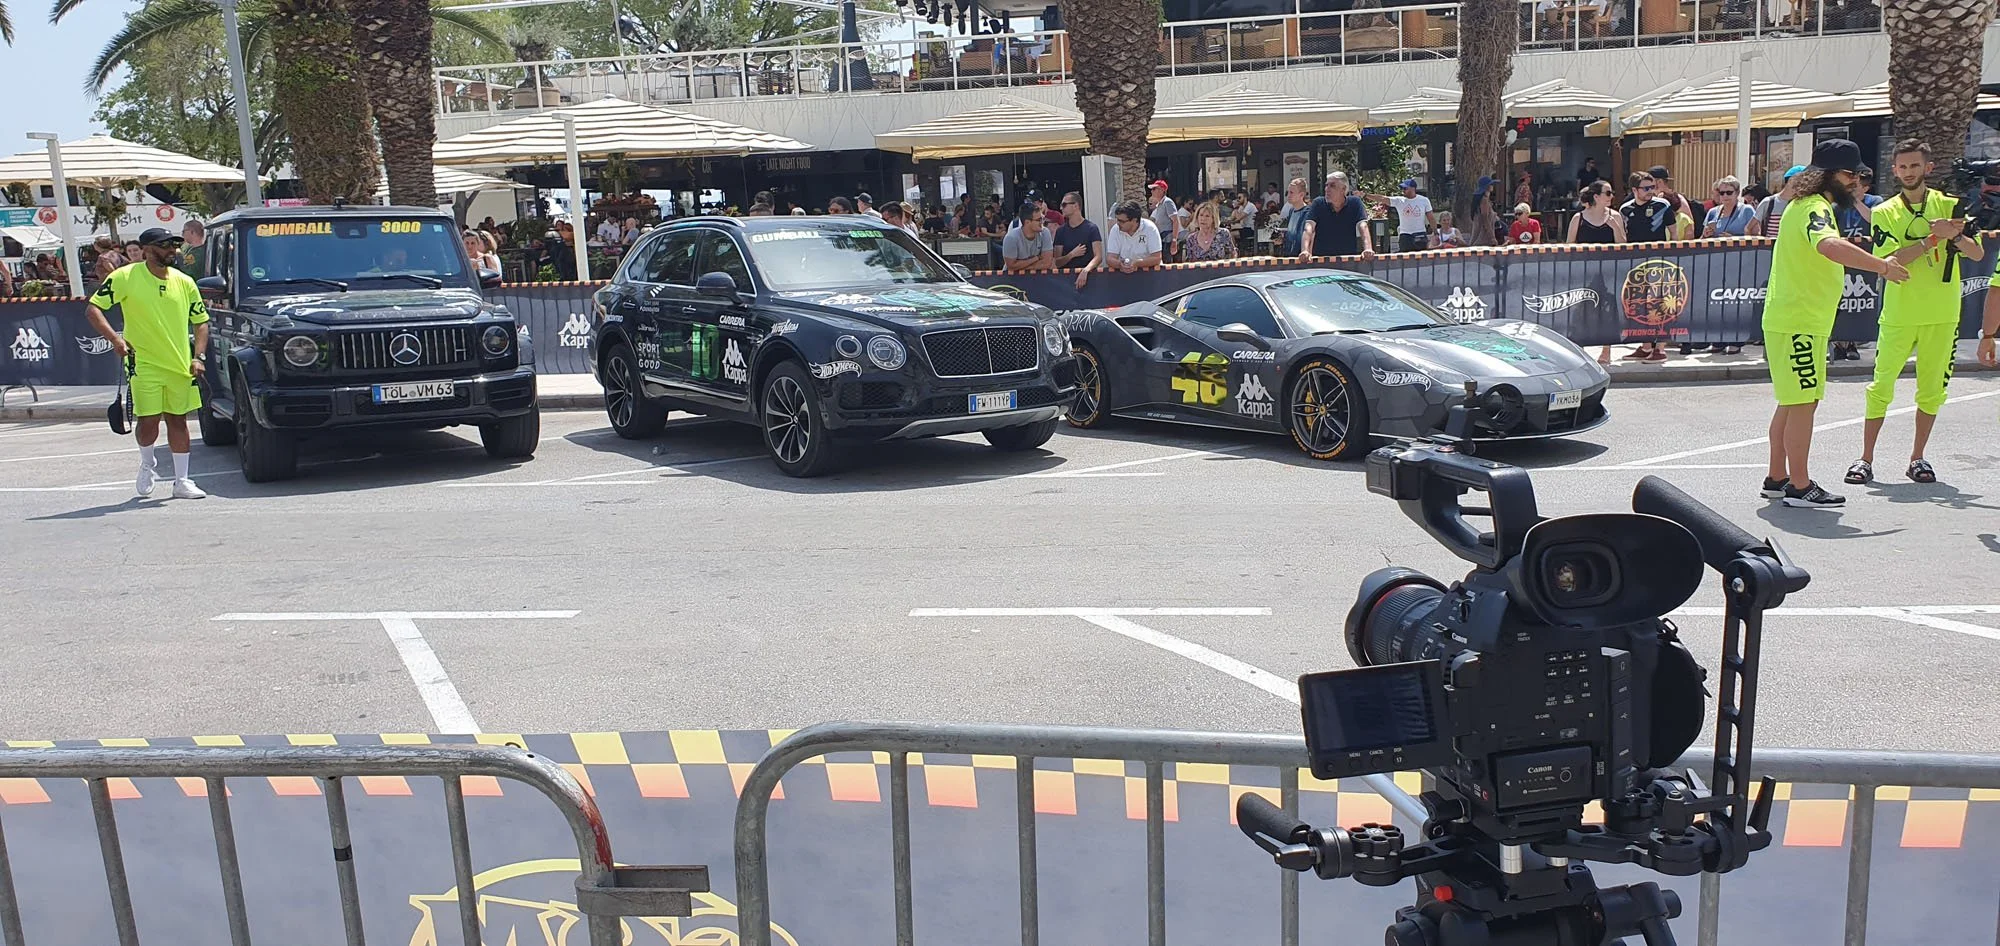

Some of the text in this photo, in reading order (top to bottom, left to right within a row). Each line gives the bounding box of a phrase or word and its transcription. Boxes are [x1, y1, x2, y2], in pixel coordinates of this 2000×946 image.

[73, 214, 143, 228] Moight
[256, 220, 422, 237] GUMBALL 3000
[752, 230, 823, 243] GUMBALL
[1710, 287, 1768, 300] CARRE
[1838, 297, 1875, 313] appa
[720, 314, 746, 327] CARRERA
[1453, 307, 1485, 323] appa
[560, 334, 591, 349] Kapp
[638, 342, 660, 354] SPORT
[13, 347, 49, 362] Kappa
[1232, 350, 1276, 361] CARRERA
[638, 359, 661, 370] GOOD
[724, 364, 747, 385] Kappa
[417, 384, 434, 397] VM
[436, 382, 453, 396] 63
[1237, 399, 1274, 419] Kappa
[1527, 765, 1553, 774] Canon
